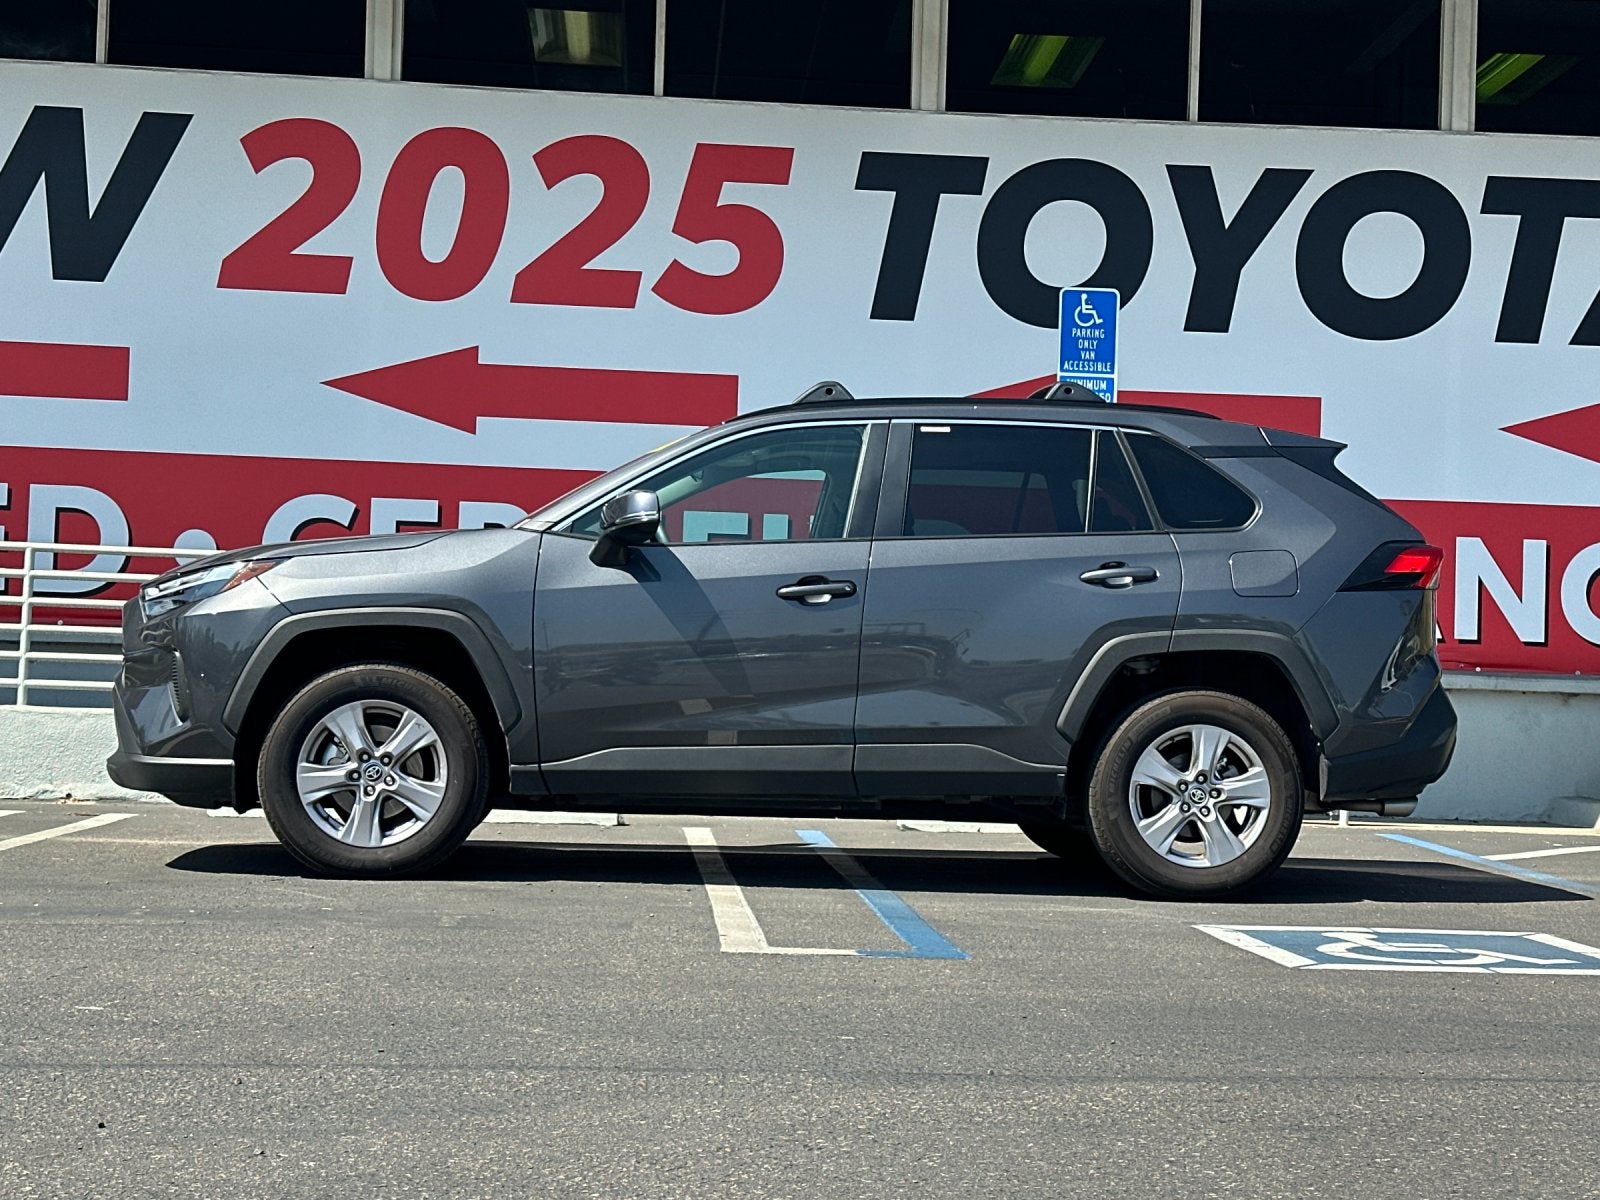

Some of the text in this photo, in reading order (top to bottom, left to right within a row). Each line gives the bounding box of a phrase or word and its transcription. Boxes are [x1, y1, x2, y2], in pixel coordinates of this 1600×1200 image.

[0, 105, 1600, 346] W 2025 TOYOT
[1072, 328, 1105, 338] PARKING
[1078, 339, 1098, 349] ONLY
[1080, 350, 1095, 360] VAN
[1063, 361, 1111, 372] ACCESSIBLE
[0, 483, 132, 597] D
